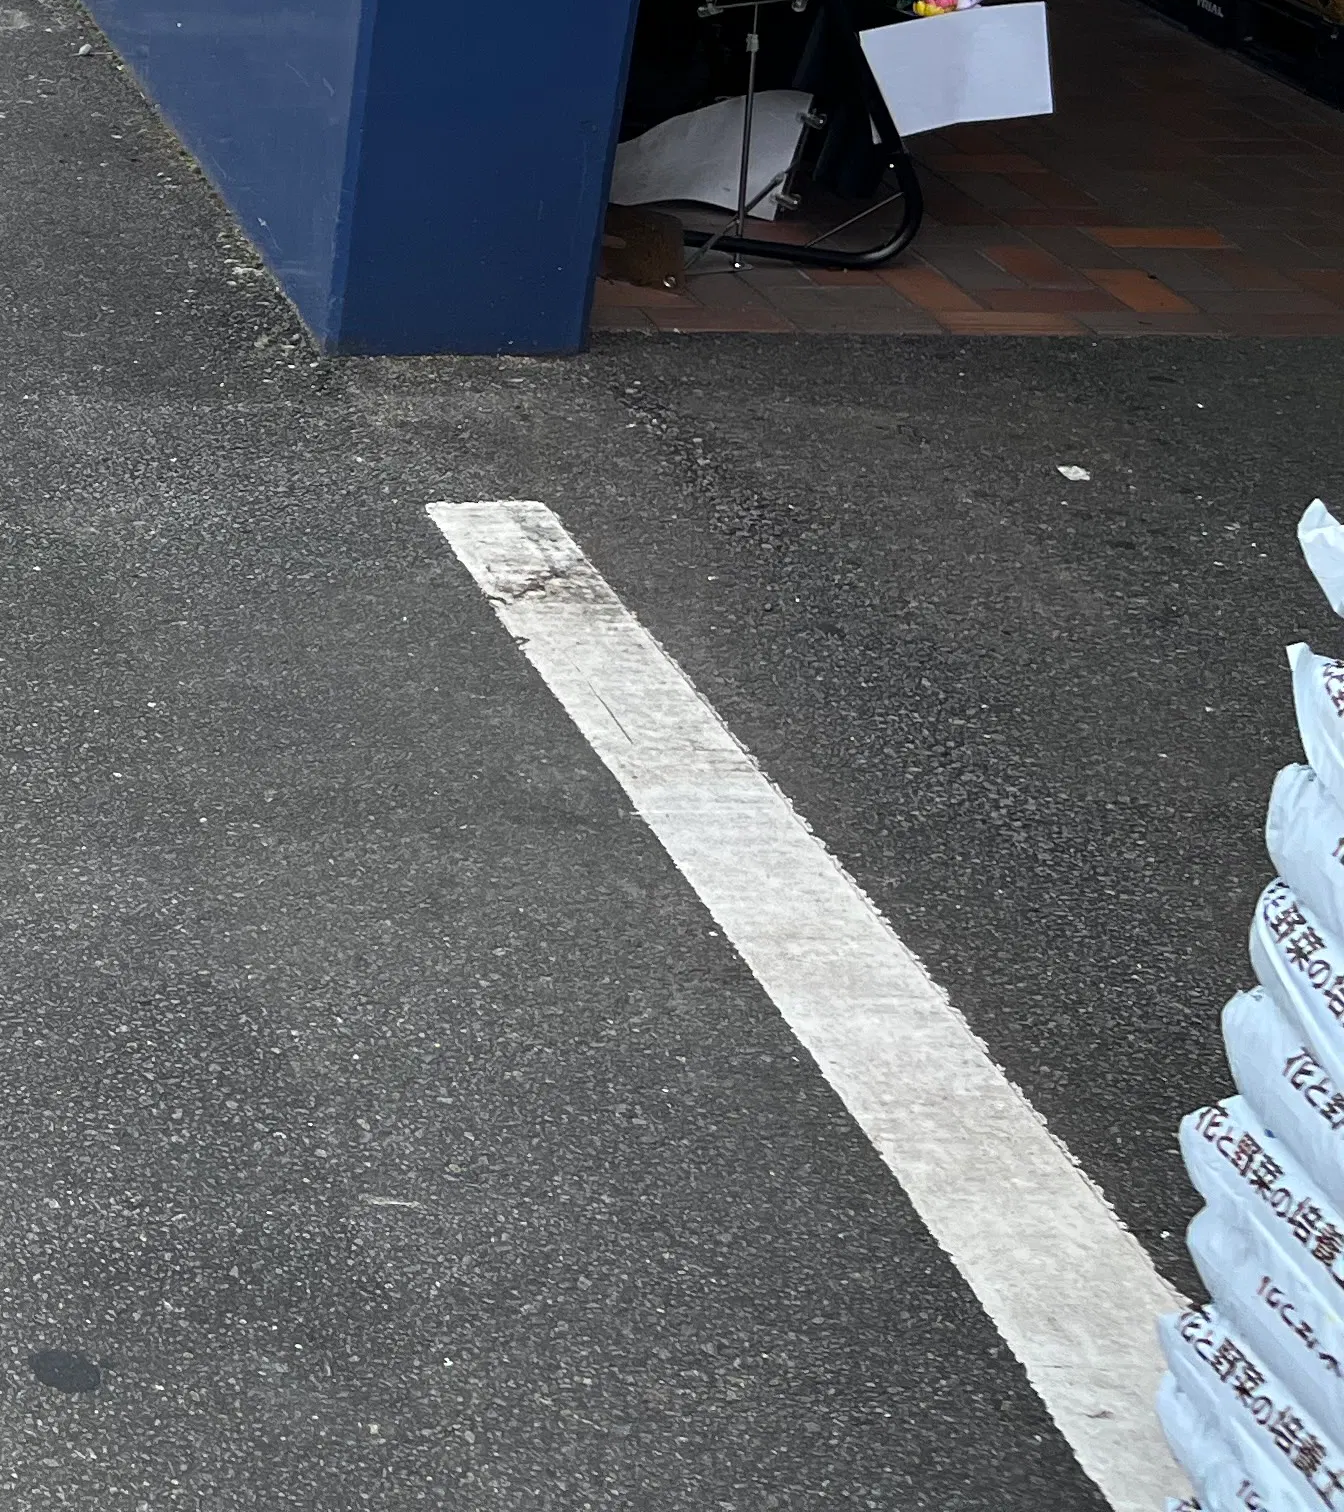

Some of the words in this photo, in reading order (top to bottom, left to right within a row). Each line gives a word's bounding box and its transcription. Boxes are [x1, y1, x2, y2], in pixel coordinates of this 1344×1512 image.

[1196, 1101, 1344, 1289] 花と野菜の培養
